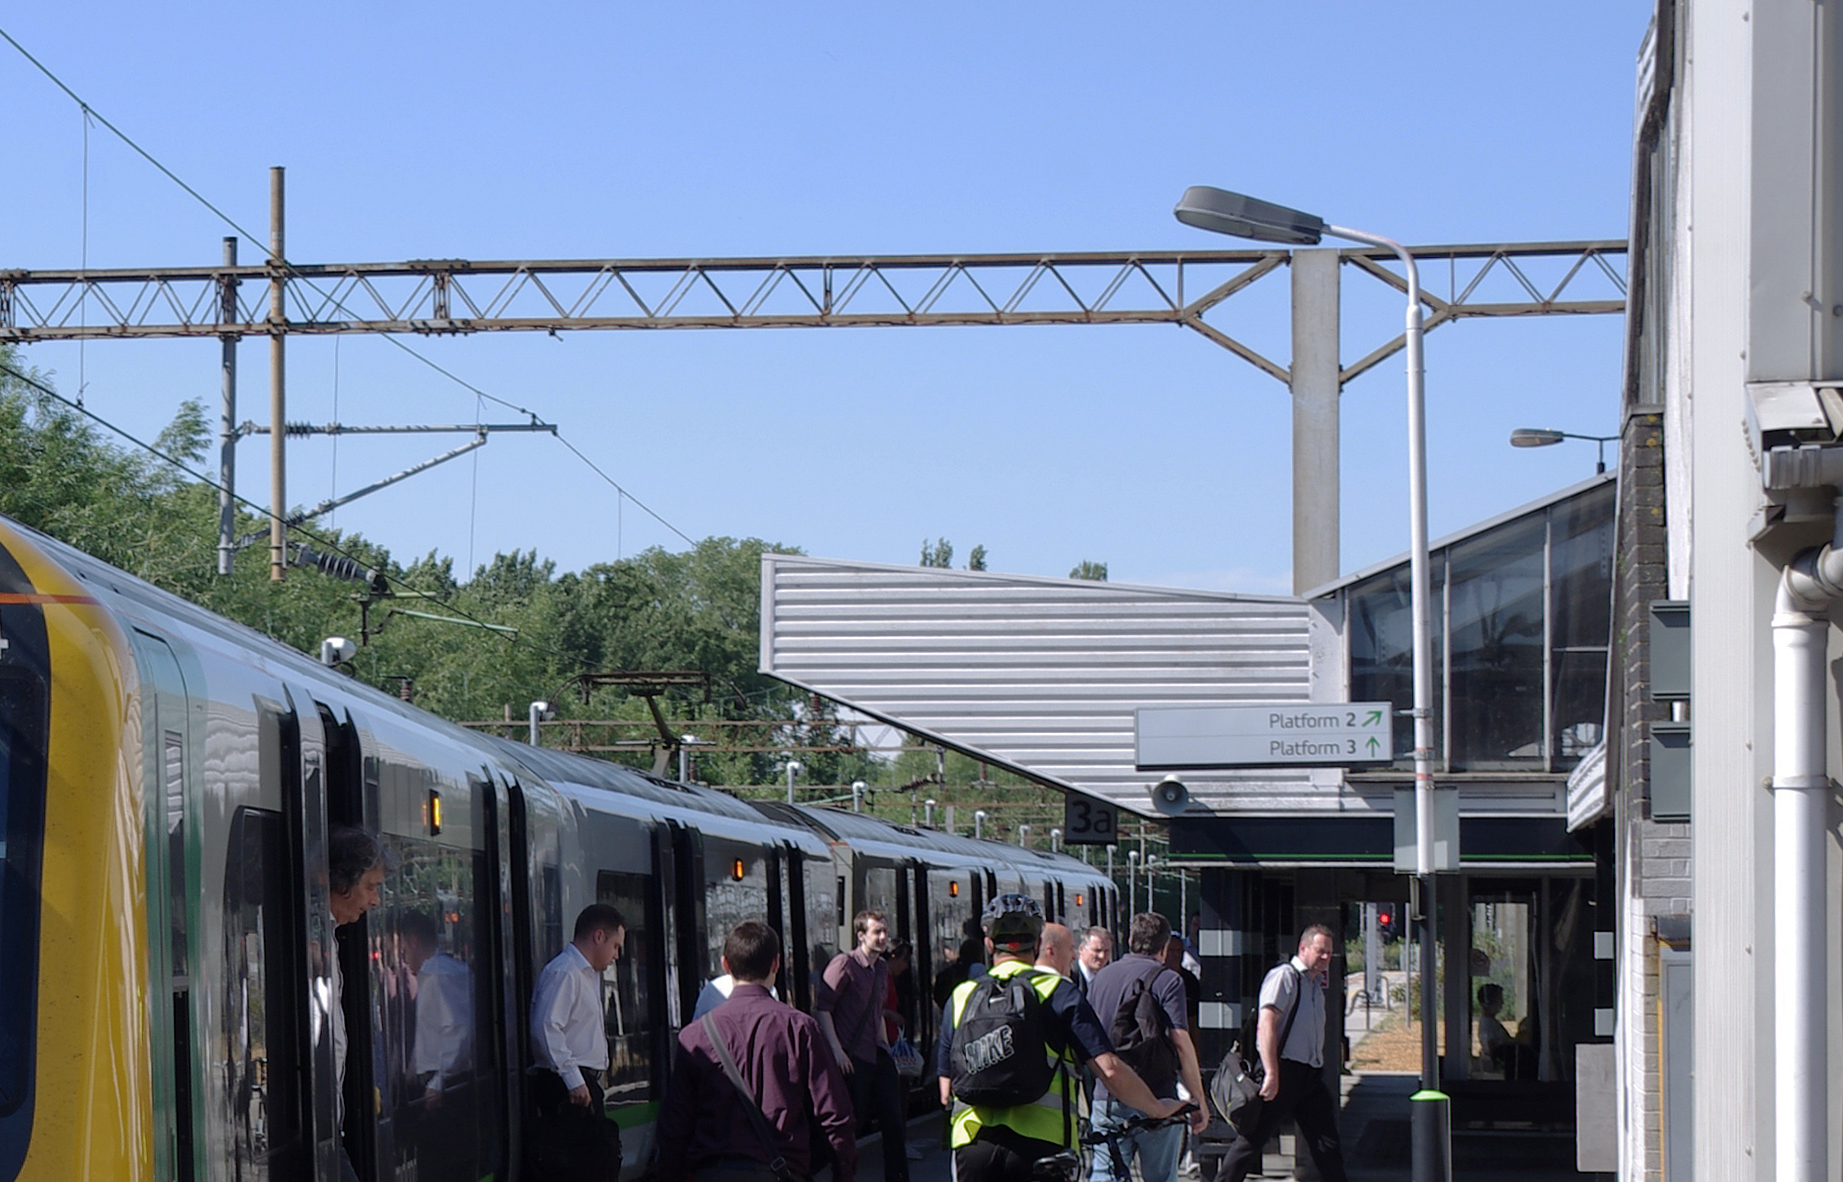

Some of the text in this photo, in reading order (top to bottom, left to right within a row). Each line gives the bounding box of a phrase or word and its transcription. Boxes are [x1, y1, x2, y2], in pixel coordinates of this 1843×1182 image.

[1269, 711, 1356, 729] Platform 2
[1269, 739, 1356, 756] Platform 3
[1071, 800, 1112, 834] 3a
[965, 1024, 1015, 1075] NIKE
